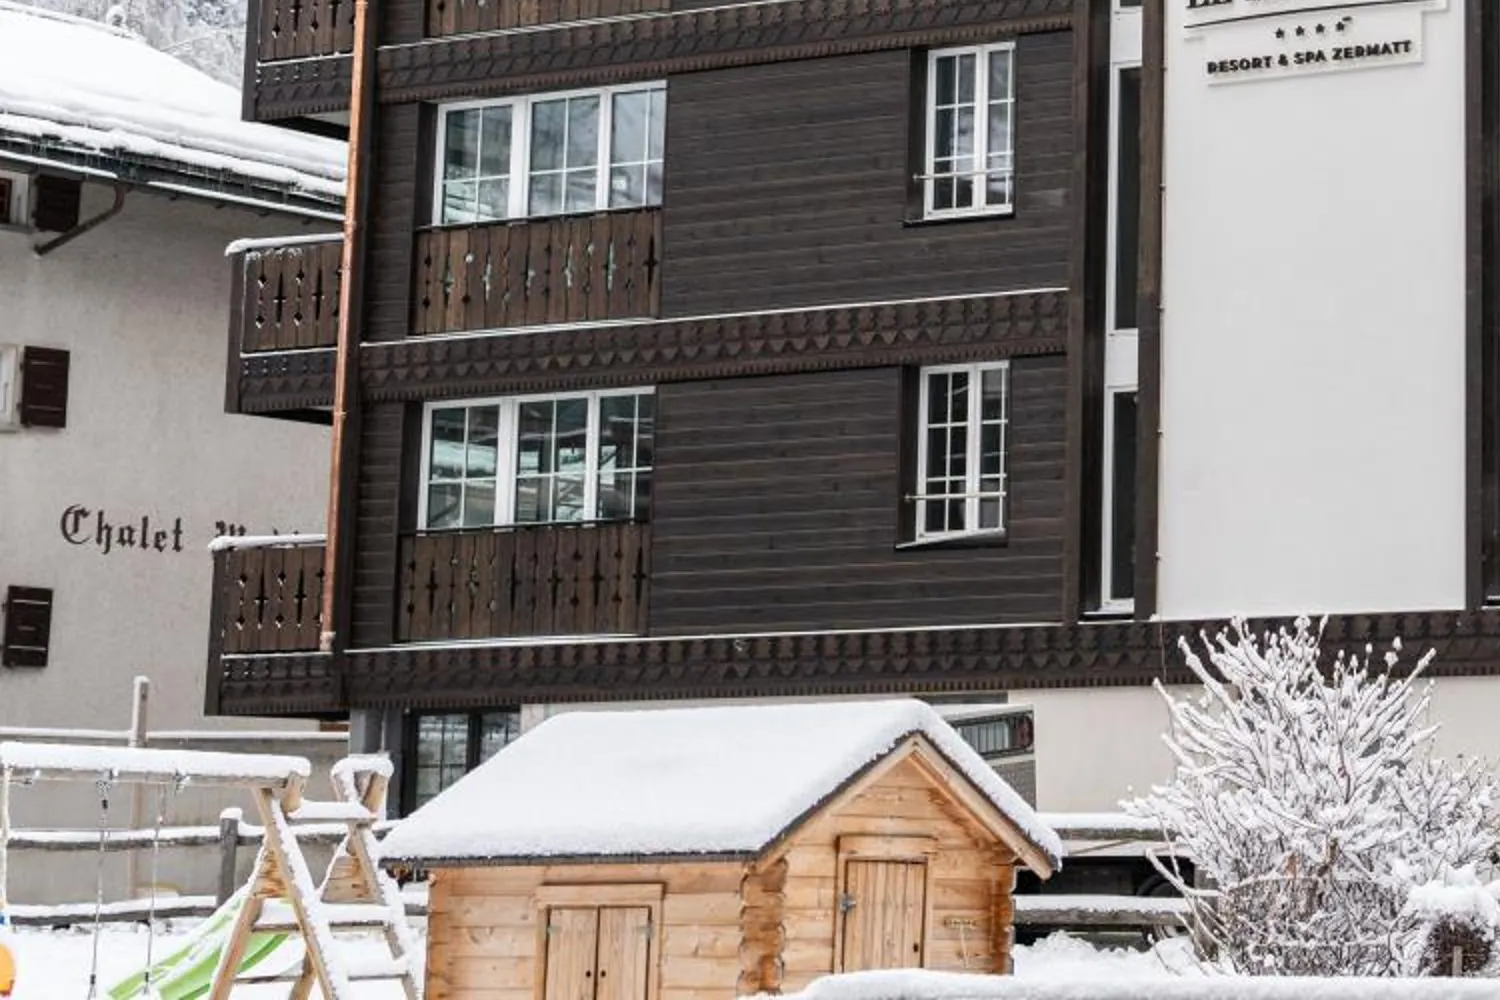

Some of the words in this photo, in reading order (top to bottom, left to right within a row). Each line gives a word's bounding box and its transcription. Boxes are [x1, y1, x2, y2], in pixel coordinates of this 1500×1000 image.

[1207, 55, 1273, 75] RESORT
[1277, 53, 1290, 67] &
[1293, 49, 1328, 65] SPA
[1331, 39, 1413, 61] ZERMATT
[60, 504, 184, 555] Chalet
